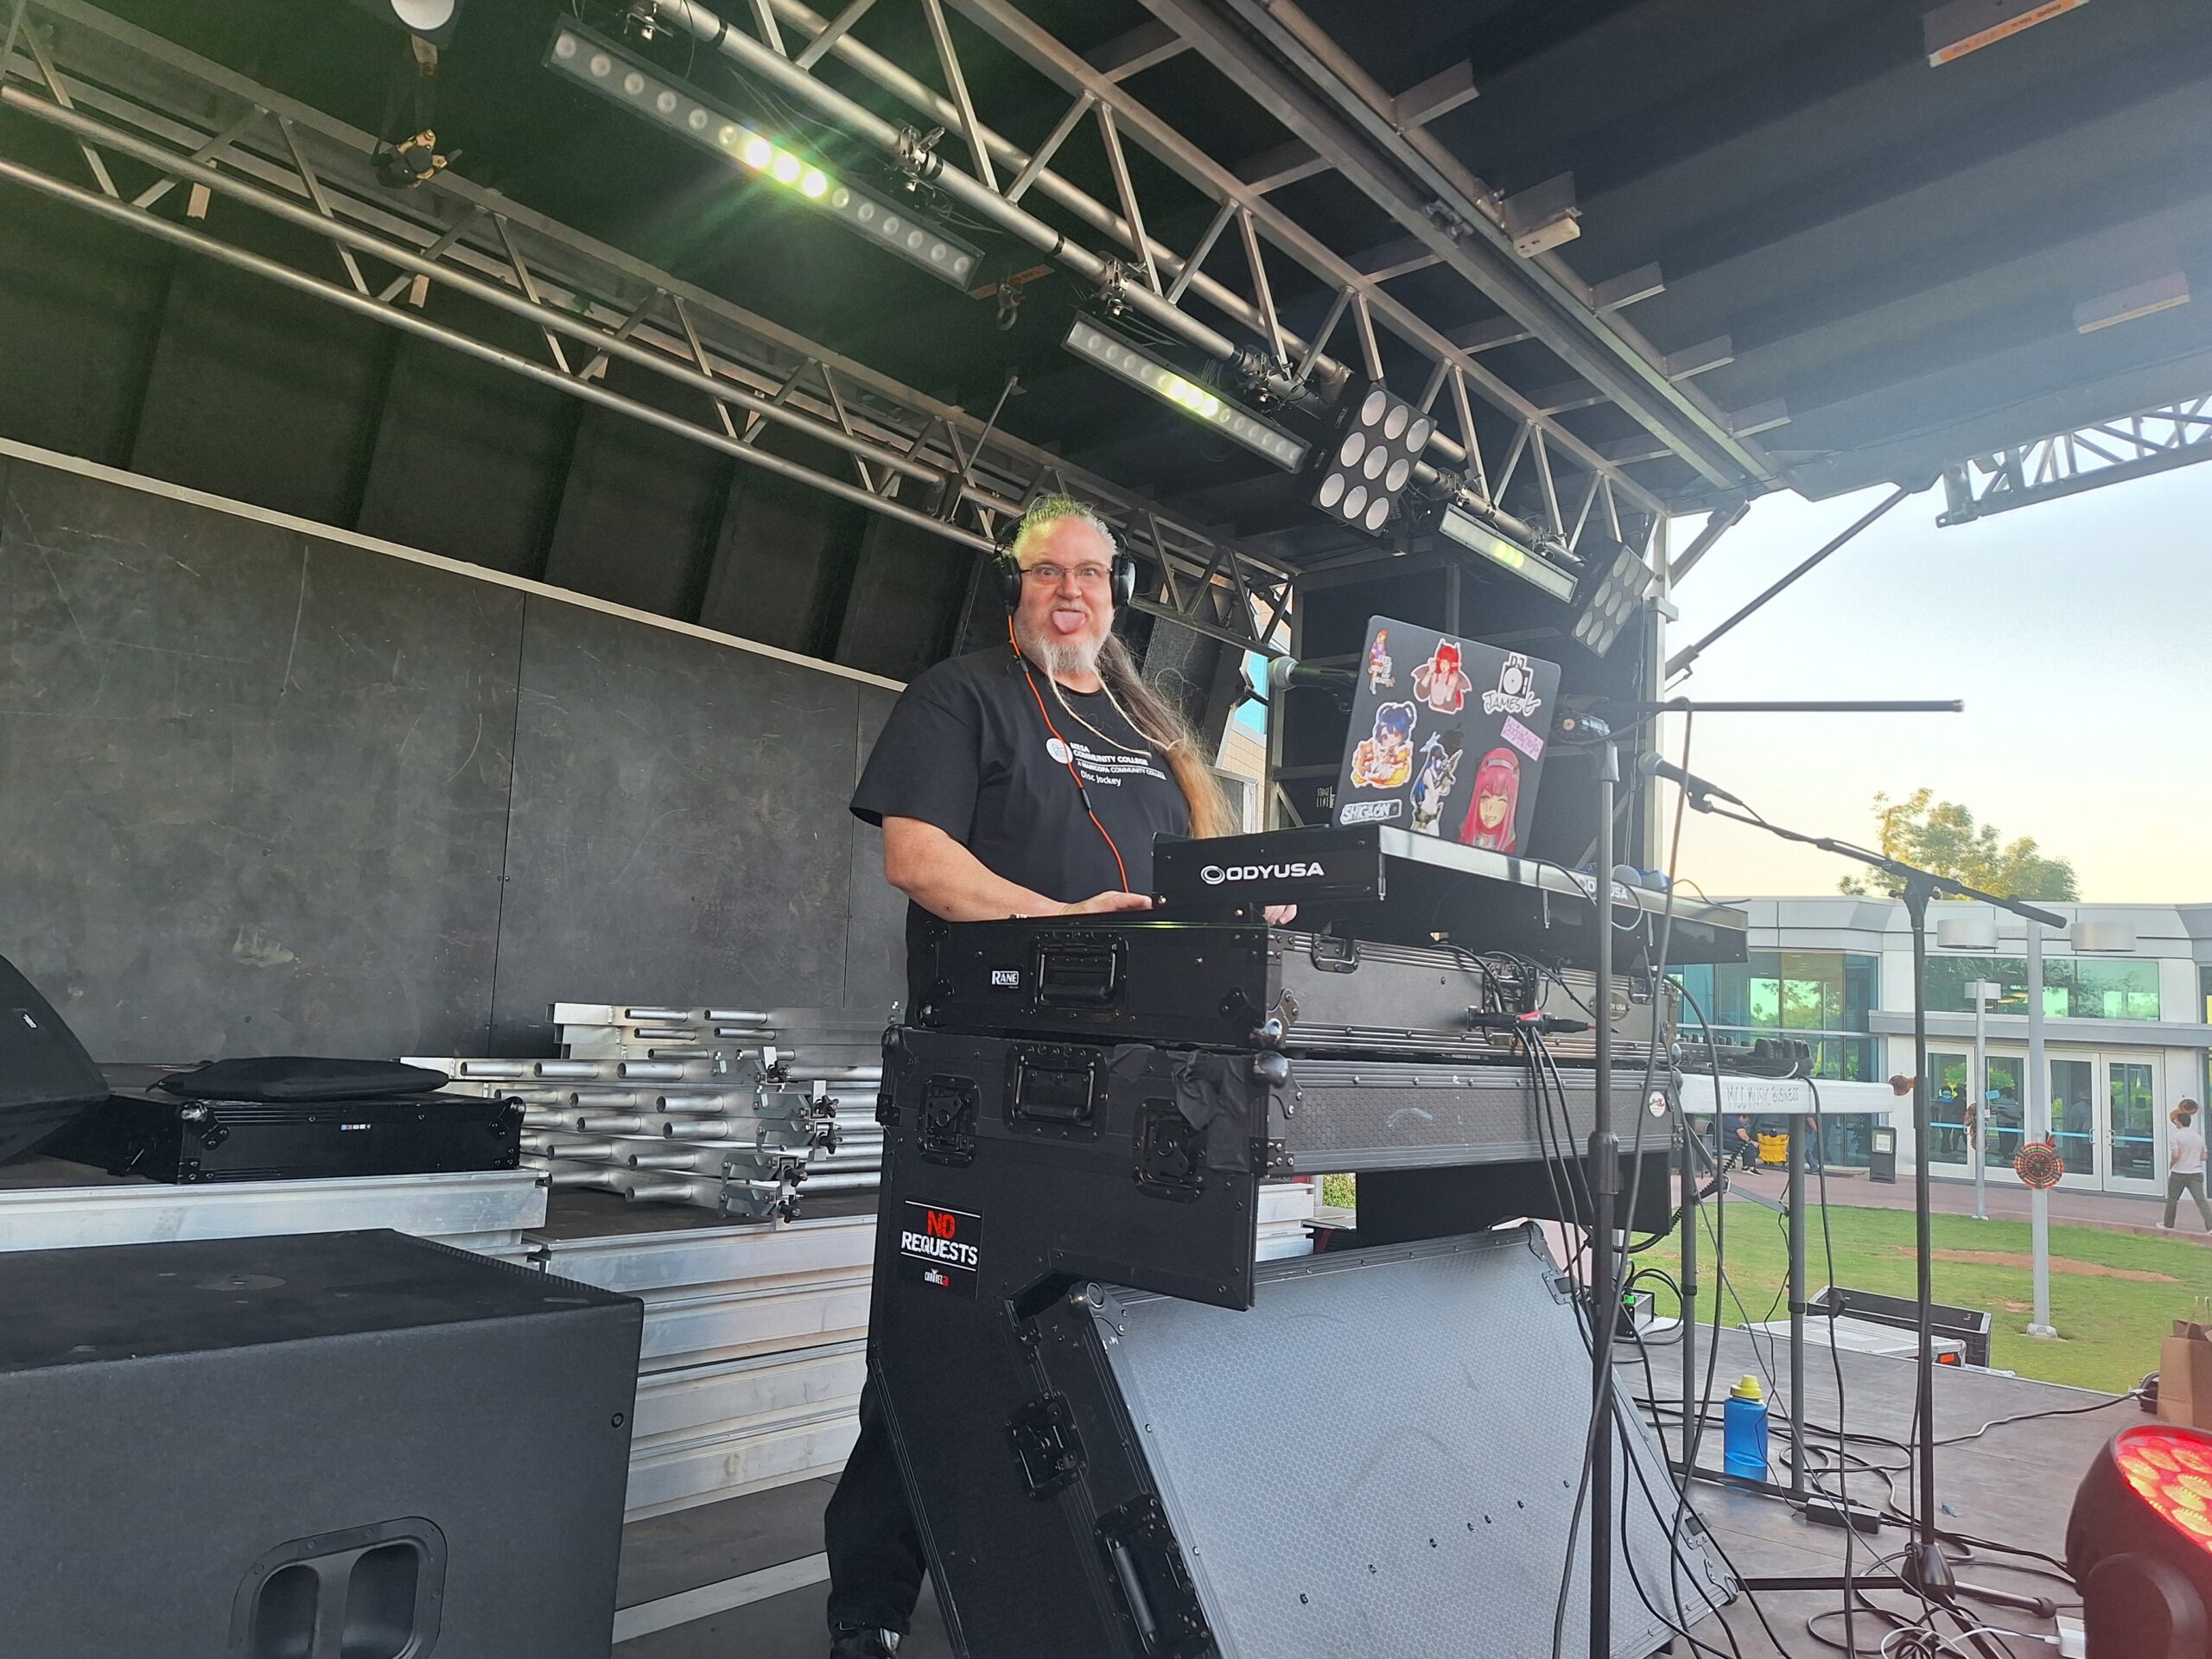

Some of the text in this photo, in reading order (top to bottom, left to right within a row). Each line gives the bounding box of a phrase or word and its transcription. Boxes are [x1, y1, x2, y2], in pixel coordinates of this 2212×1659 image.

[1510, 656, 1525, 670] DJ
[1484, 692, 1521, 712] JAMES
[1070, 742, 1090, 753] MESA
[1073, 749, 1148, 766] COMMUNITY COLLEGE
[1082, 761, 1110, 773] MARICOPA
[1080, 770, 1122, 787] Disc Jockey
[1226, 861, 1325, 880] ODYUSA
[991, 970, 1017, 985] RANE
[927, 1211, 956, 1239] NO
[901, 1230, 978, 1265] REQUESTS
